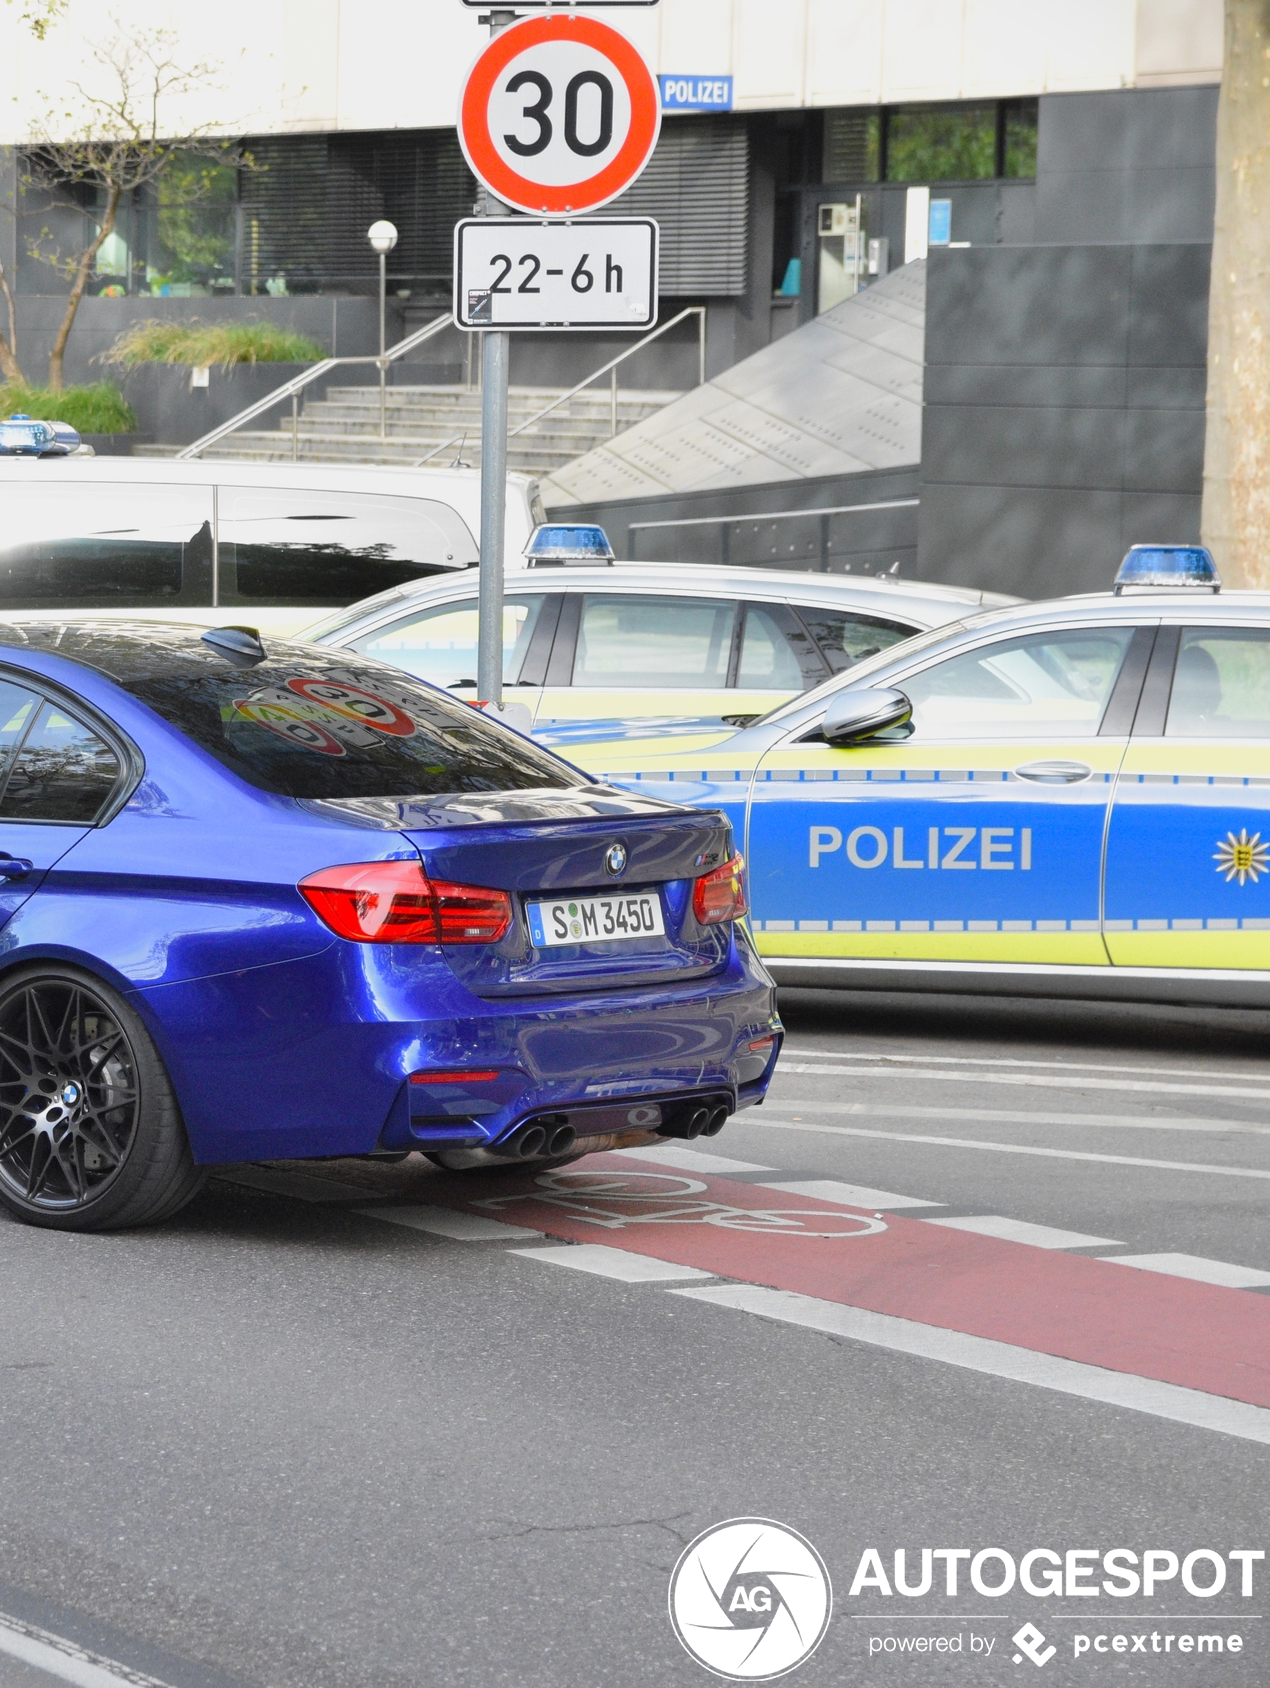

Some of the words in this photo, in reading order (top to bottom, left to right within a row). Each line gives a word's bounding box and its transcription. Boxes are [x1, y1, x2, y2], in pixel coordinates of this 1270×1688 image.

[503, 70, 614, 157] 30
[664, 80, 729, 103] POLIZEI
[809, 825, 1032, 870] POLIZEI
